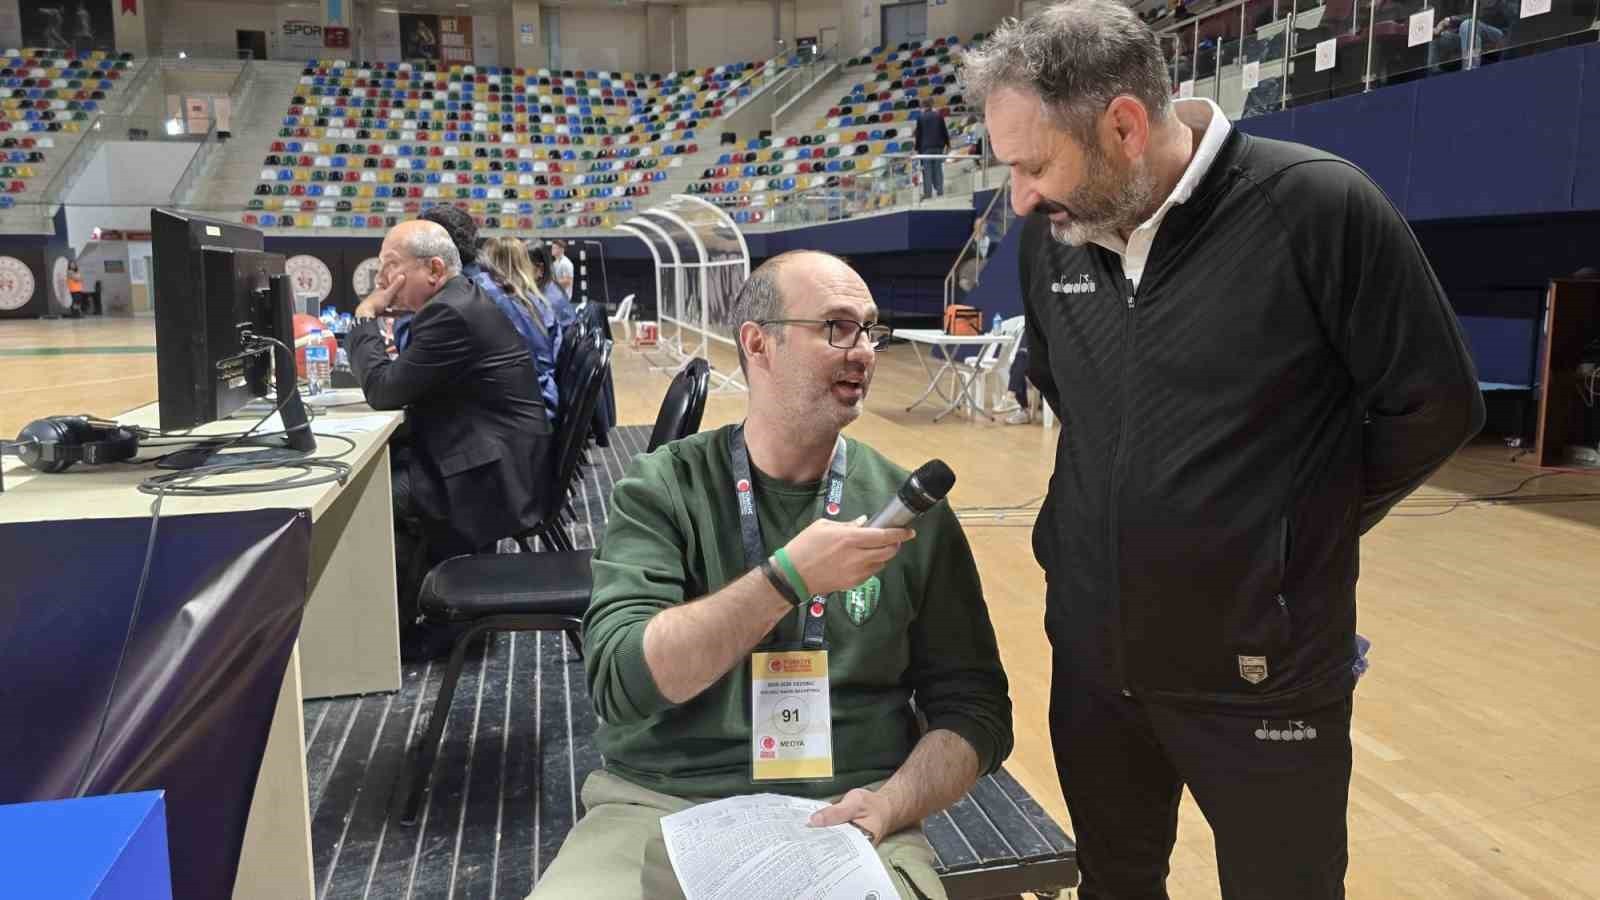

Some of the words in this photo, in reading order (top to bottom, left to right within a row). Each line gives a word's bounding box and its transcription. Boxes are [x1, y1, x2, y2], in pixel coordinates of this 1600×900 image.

[1051, 273, 1096, 294] diadora
[782, 708, 800, 722] 91
[1254, 719, 1317, 741] diadora
